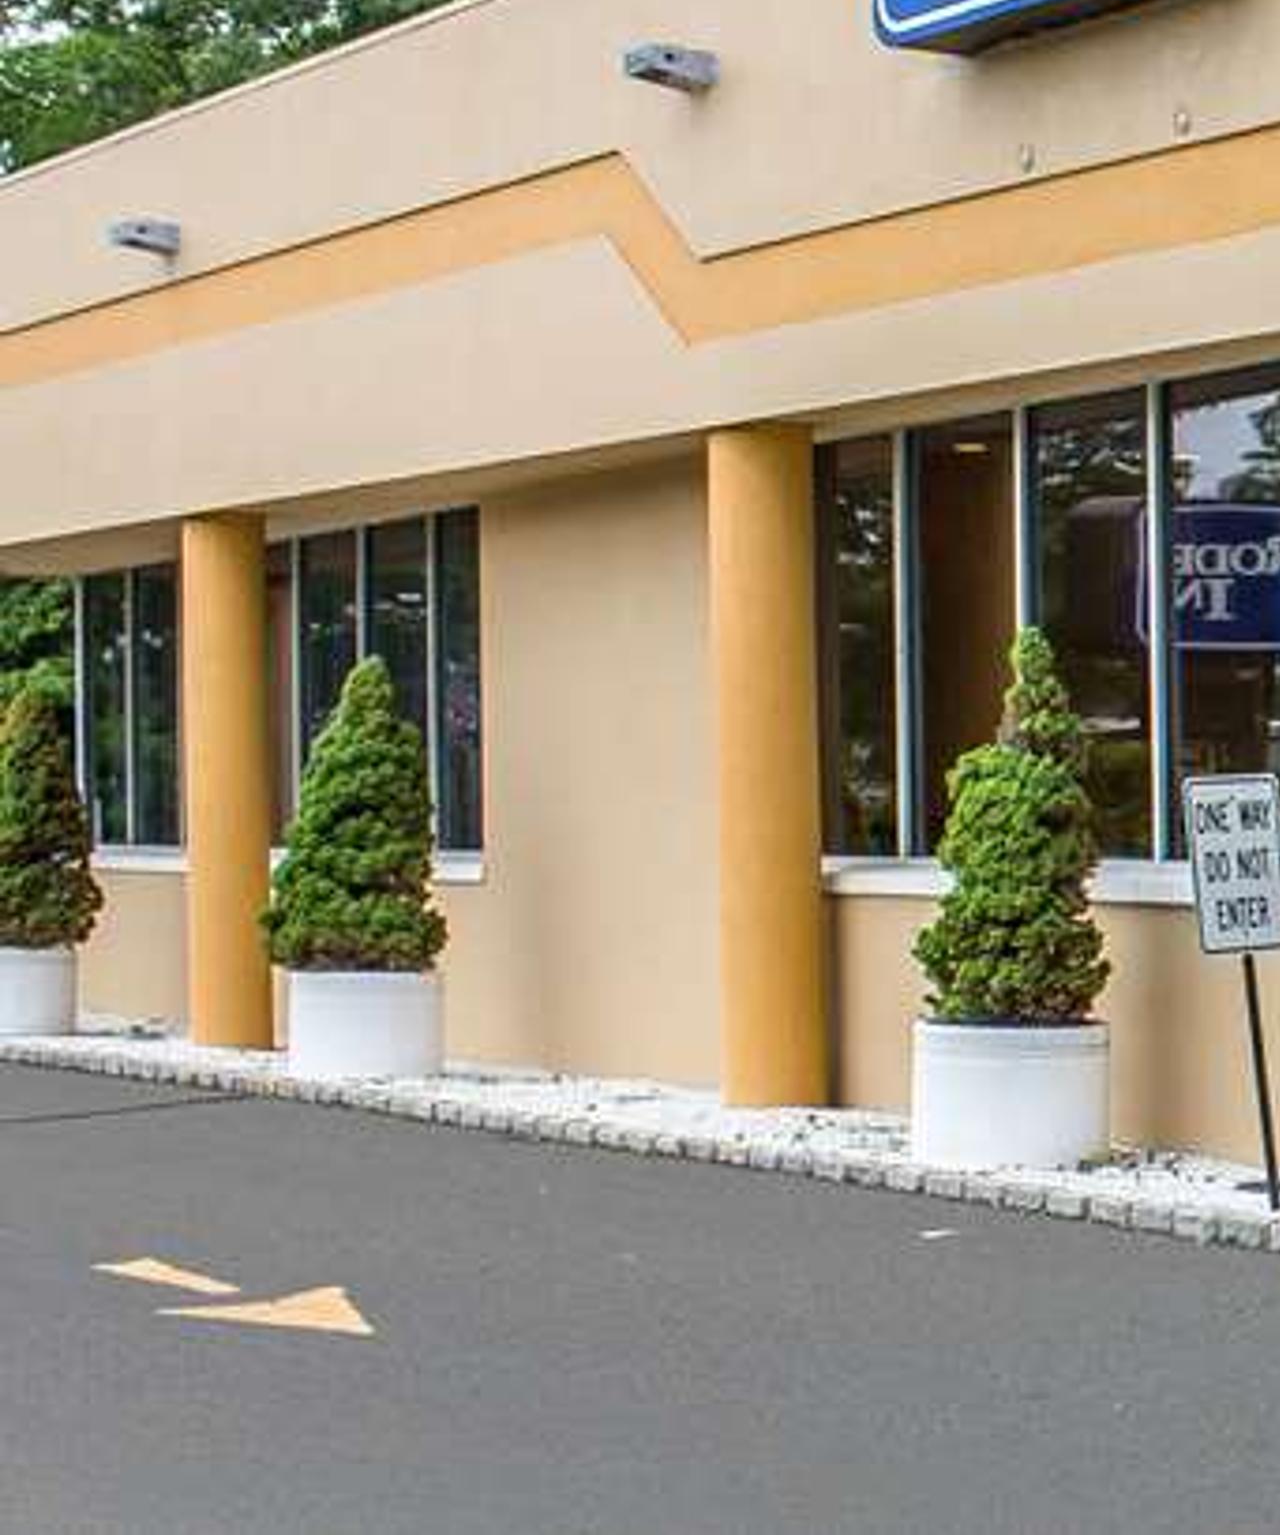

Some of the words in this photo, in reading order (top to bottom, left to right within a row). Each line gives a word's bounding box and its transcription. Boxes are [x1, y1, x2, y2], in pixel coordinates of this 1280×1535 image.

[1196, 800, 1231, 835] ONE
[1237, 799, 1272, 831] WAY
[1204, 850, 1231, 884] DO
[1236, 847, 1270, 880] NOT
[1216, 896, 1271, 932] ENTER
